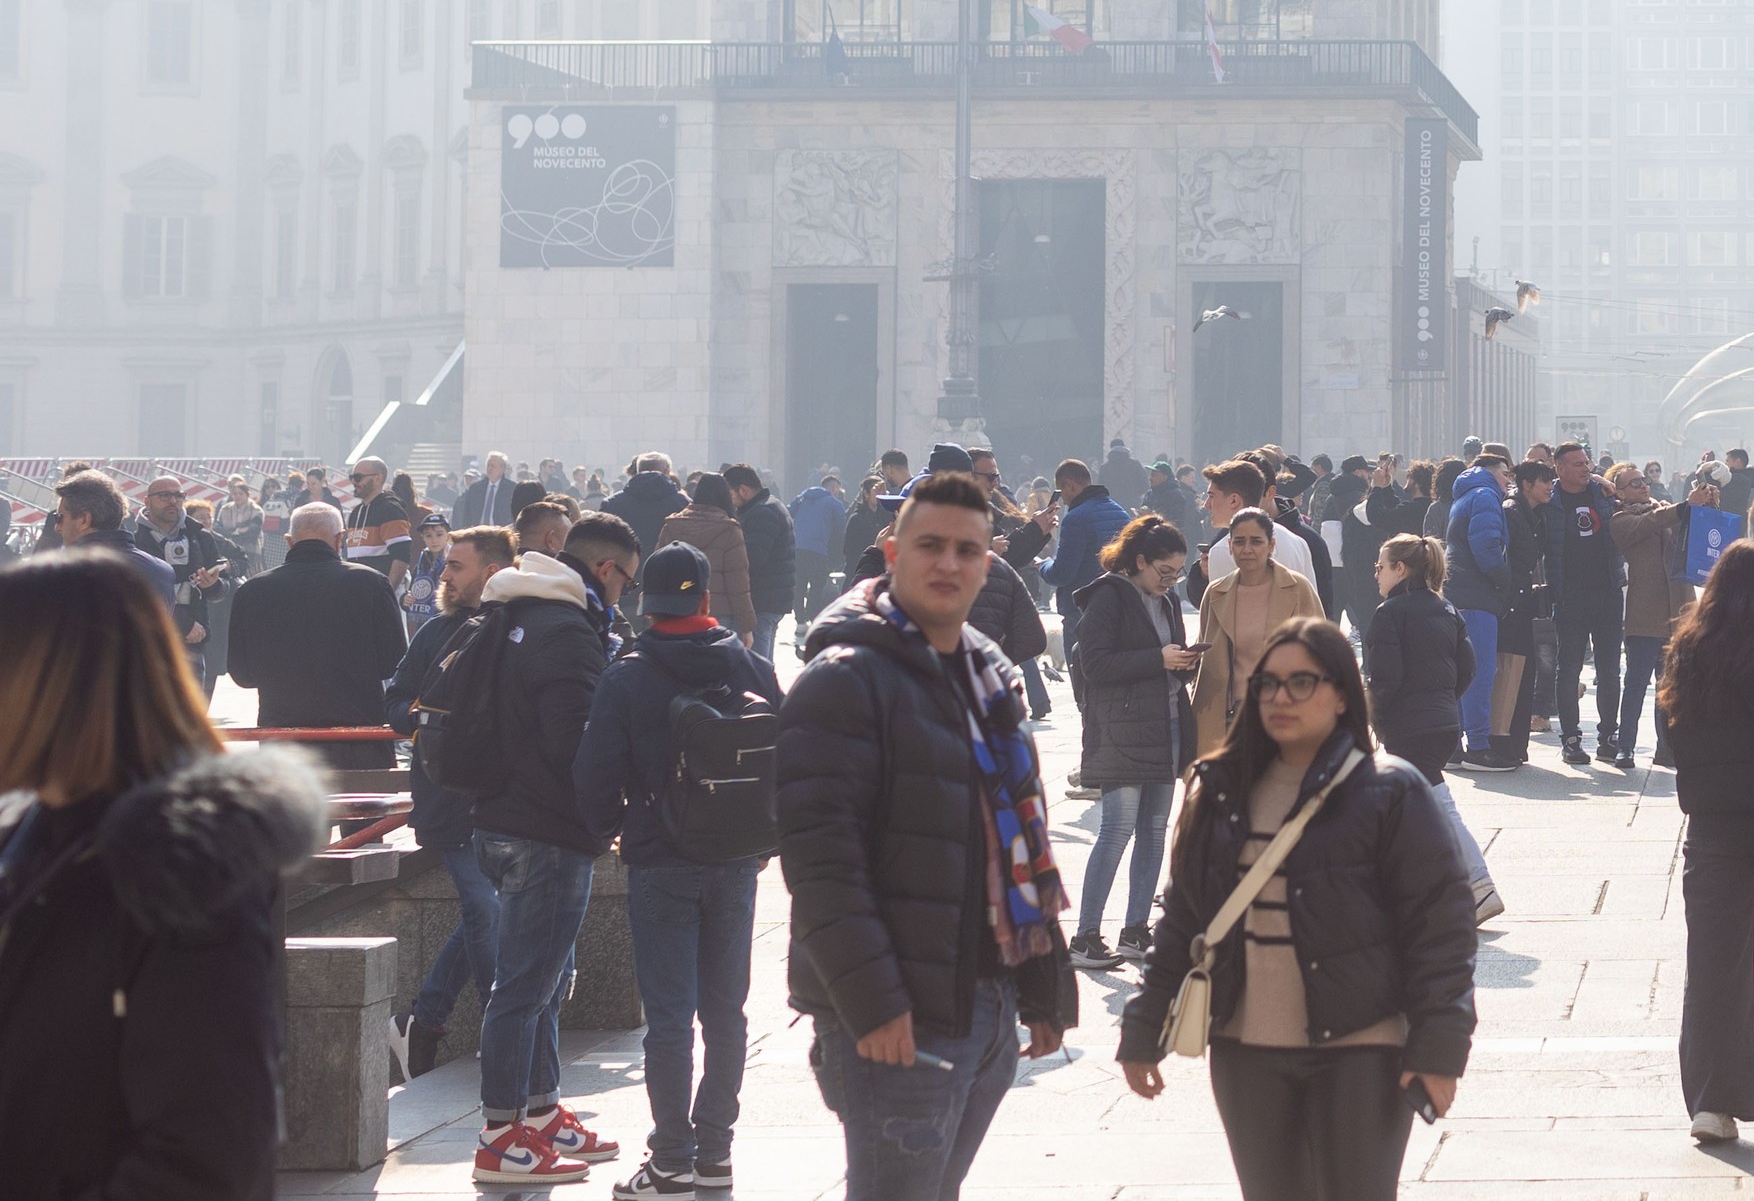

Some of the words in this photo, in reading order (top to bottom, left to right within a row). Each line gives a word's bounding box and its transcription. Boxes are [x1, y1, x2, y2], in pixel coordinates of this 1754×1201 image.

[533, 147, 575, 158] MUSEO
[578, 147, 600, 158] DEL
[533, 158, 606, 169] NOVECENTO
[1419, 130, 1432, 217] NOVECENTO
[1419, 221, 1431, 247] DEL
[1418, 251, 1430, 301] MUSEO
